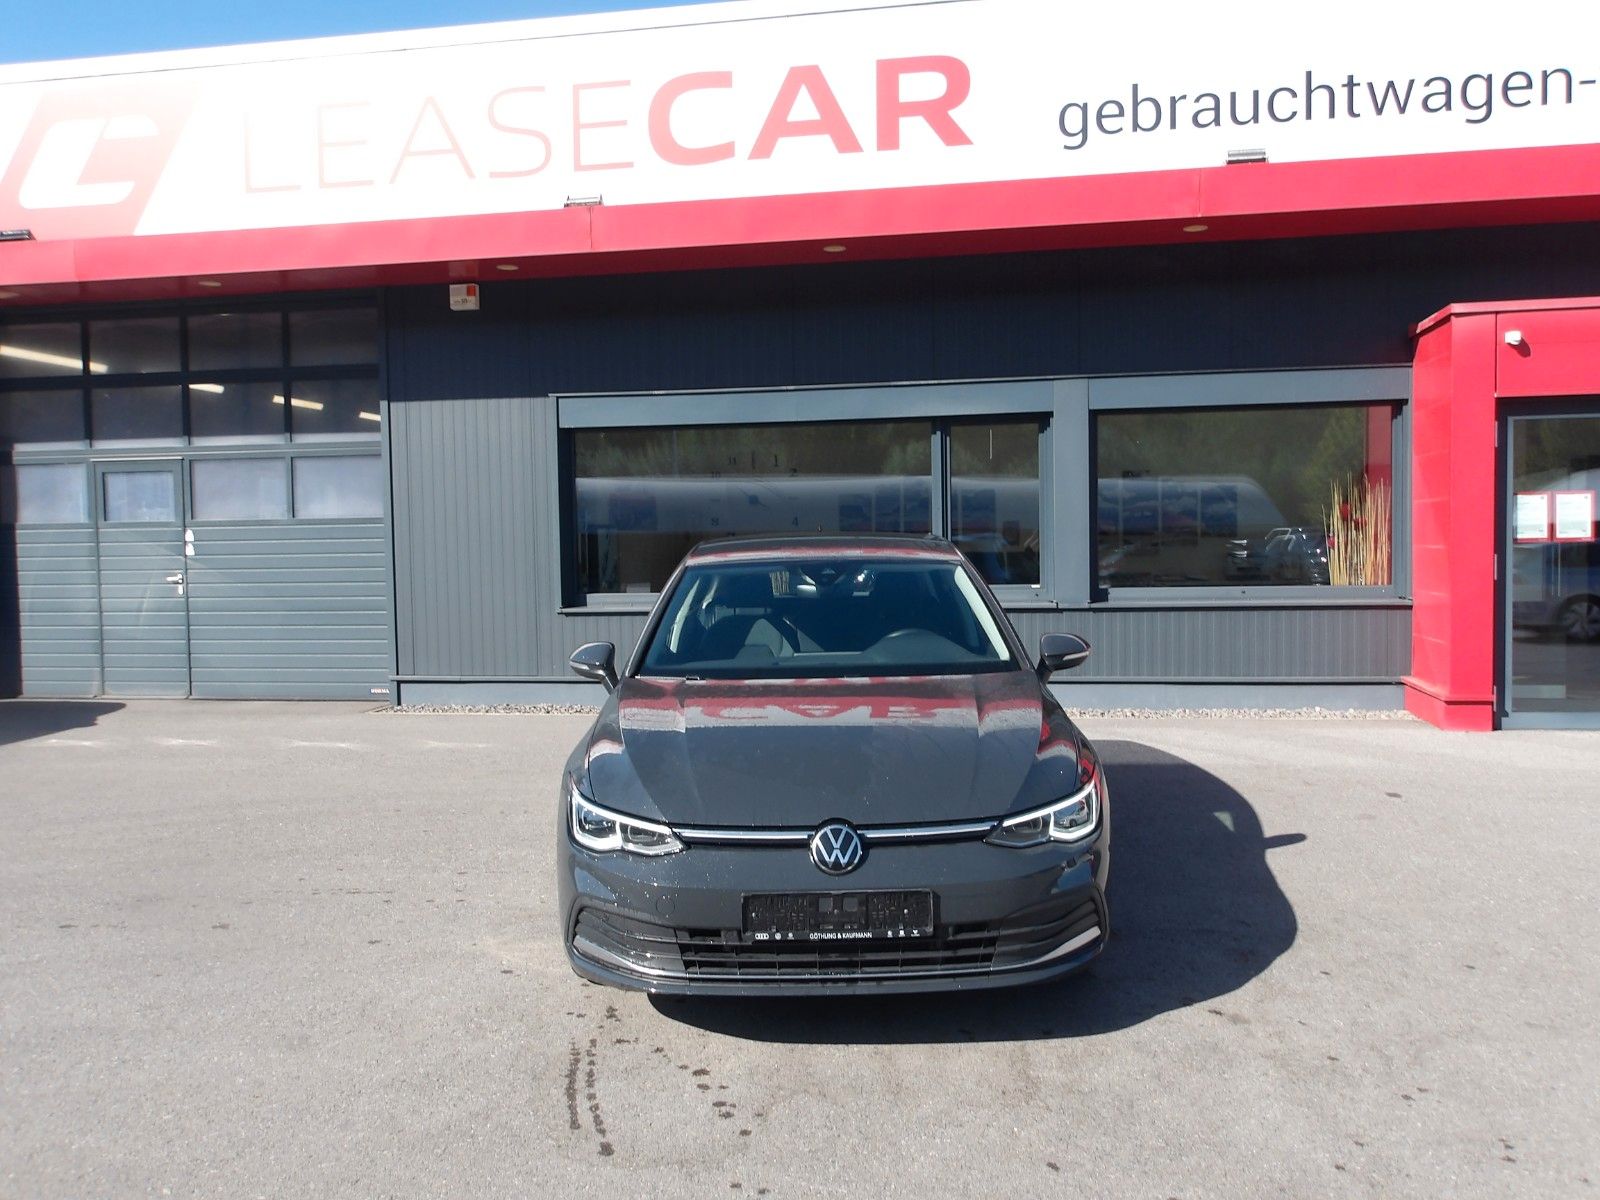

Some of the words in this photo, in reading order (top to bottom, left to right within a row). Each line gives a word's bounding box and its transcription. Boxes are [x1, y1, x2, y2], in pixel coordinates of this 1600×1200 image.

[242, 54, 974, 193] LEASECAR
[1058, 68, 1597, 151] gebrauchtwagen-
[842, 931, 873, 940] KAUFMANN
